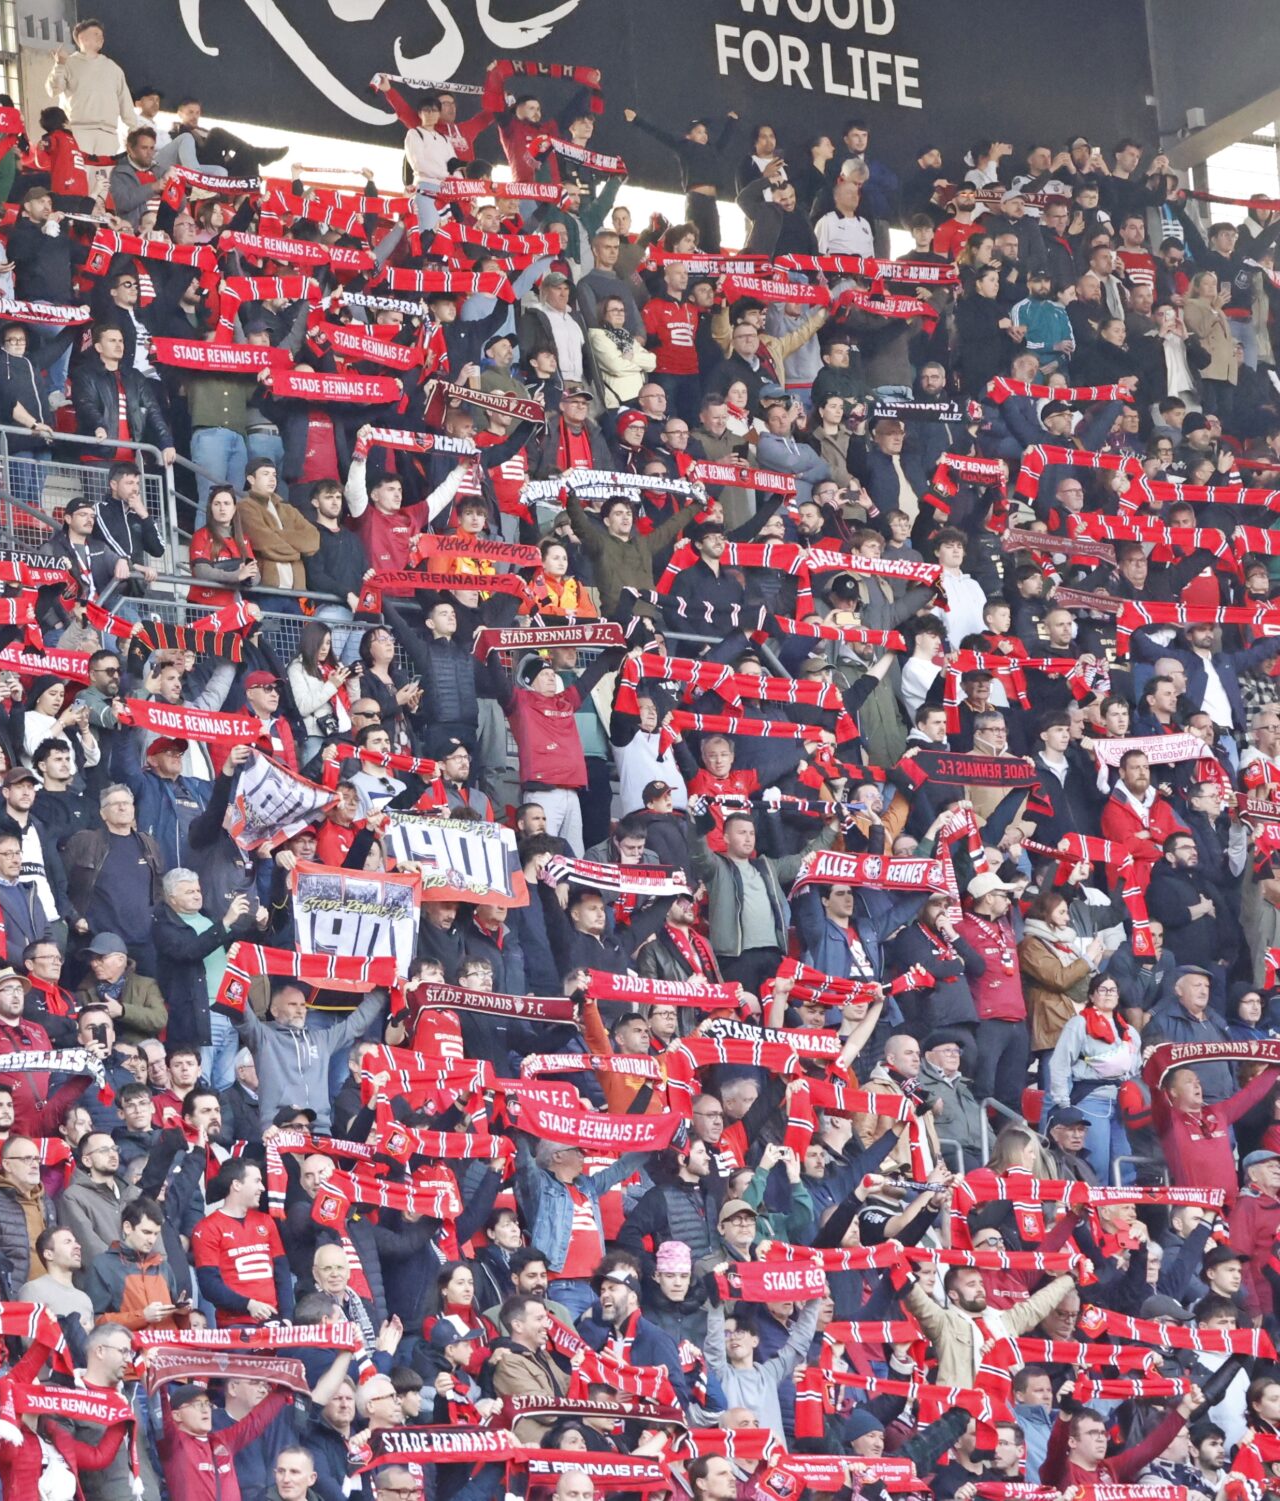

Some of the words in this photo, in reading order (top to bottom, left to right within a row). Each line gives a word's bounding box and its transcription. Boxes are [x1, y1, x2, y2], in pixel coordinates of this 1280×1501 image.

[714, 23, 813, 90] FOR
[820, 42, 923, 109] LIFE
[541, 185, 558, 198] CLUB
[234, 231, 262, 250] STADE
[263, 236, 303, 257] RENNAIS
[304, 243, 323, 259] F.C.
[733, 274, 761, 292] STADE
[762, 279, 795, 297] RENNAIS
[797, 282, 817, 298] F.C.
[173, 344, 206, 361] STADE
[208, 347, 250, 364] RENNAIS
[253, 350, 272, 366] F.C.
[333, 330, 360, 349] STADE
[361, 337, 397, 360] RENNAIS
[397, 348, 411, 363] F.C.
[290, 376, 321, 393] STADE
[322, 380, 363, 396] RENNAIS
[366, 382, 383, 397] F.C.
[874, 409, 897, 418] ALLEZ
[939, 411, 963, 421] ALLEZ
[12, 553, 67, 570] RENNAIS
[852, 555, 915, 577] RENNAIS
[375, 572, 417, 585] STADE
[421, 573, 488, 586] RENNAIS
[500, 628, 535, 644] STADE
[537, 628, 582, 642] RENNAIS
[596, 627, 615, 641] F.C.
[148, 708, 182, 727] STADE
[184, 713, 232, 734] RENNAIS
[234, 718, 254, 736] F.C.
[1246, 799, 1275, 814] STADE
[815, 854, 857, 877] ALLEZ
[886, 862, 927, 884] RENNES
[613, 973, 651, 993] STADE
[653, 978, 701, 996] RENNAIS
[705, 984, 729, 999] F.C.
[426, 987, 461, 1006] STADE
[462, 991, 513, 1011] RENNAIS
[527, 1001, 546, 1017] F.C.
[712, 1019, 763, 1042] STADE
[1171, 1043, 1204, 1060] STADE
[1205, 1041, 1248, 1056] RENNAIS
[1261, 1044, 1278, 1058] F.C.
[551, 1092, 575, 1108] F.C.
[539, 1113, 576, 1134] STADE
[577, 1119, 633, 1142] RENNAIS
[635, 1125, 656, 1142] F.C.
[763, 1270, 803, 1292] STADE
[180, 1328, 231, 1345] RENNAIS
[269, 1325, 327, 1344] FOOTBALL
[27, 1395, 59, 1411] STADE
[61, 1398, 108, 1420] RENNAIS
[109, 1406, 131, 1421] F.C.
[384, 1432, 432, 1453] STADE
[433, 1431, 497, 1453] RENNAIS
[553, 1460, 631, 1478] RENNAIS
[634, 1463, 664, 1478] F.C.
